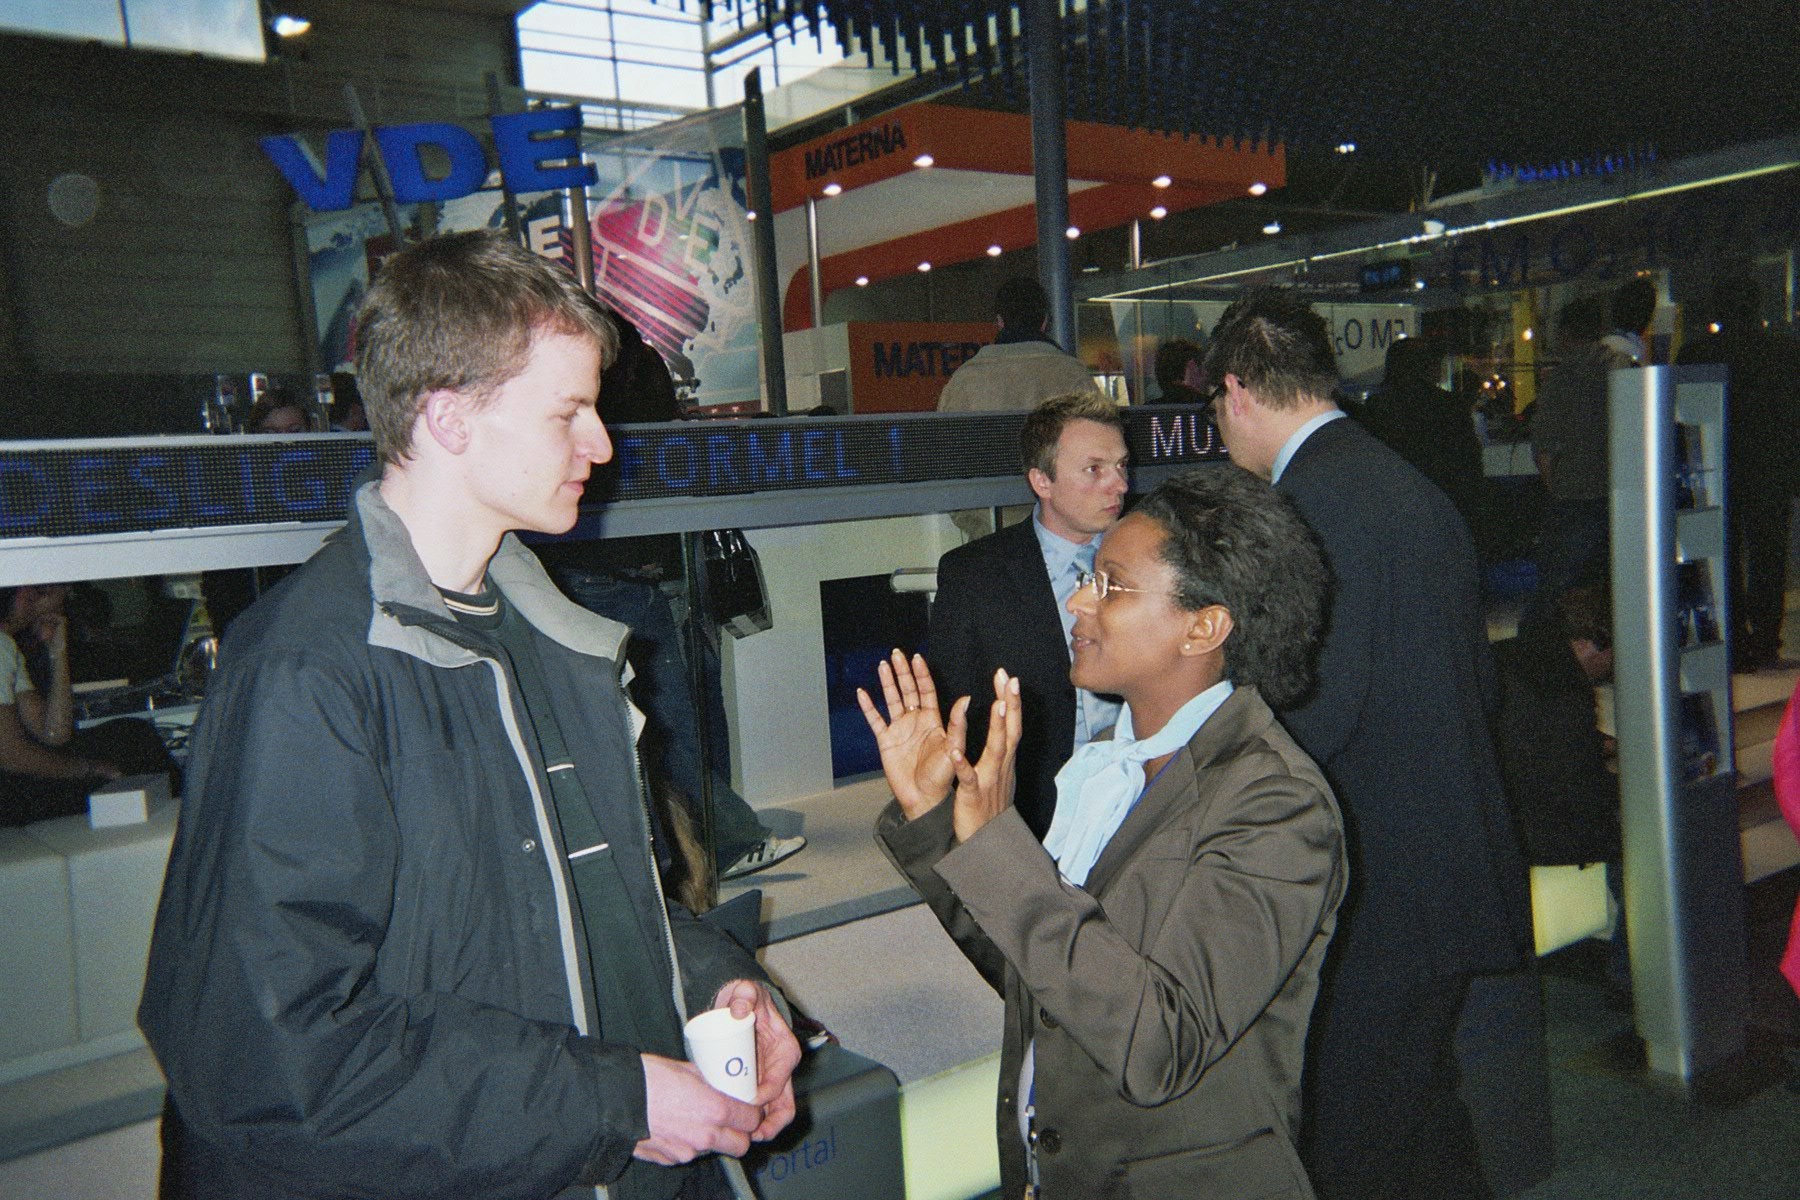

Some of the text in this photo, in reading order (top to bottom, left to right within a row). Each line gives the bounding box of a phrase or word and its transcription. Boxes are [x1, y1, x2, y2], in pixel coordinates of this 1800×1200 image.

[259, 107, 599, 212] VDE
[804, 120, 907, 180] MATERNA
[618, 430, 859, 488] FORMEL
[1151, 415, 1228, 457] MU
[753, 1125, 836, 1181] ortal
